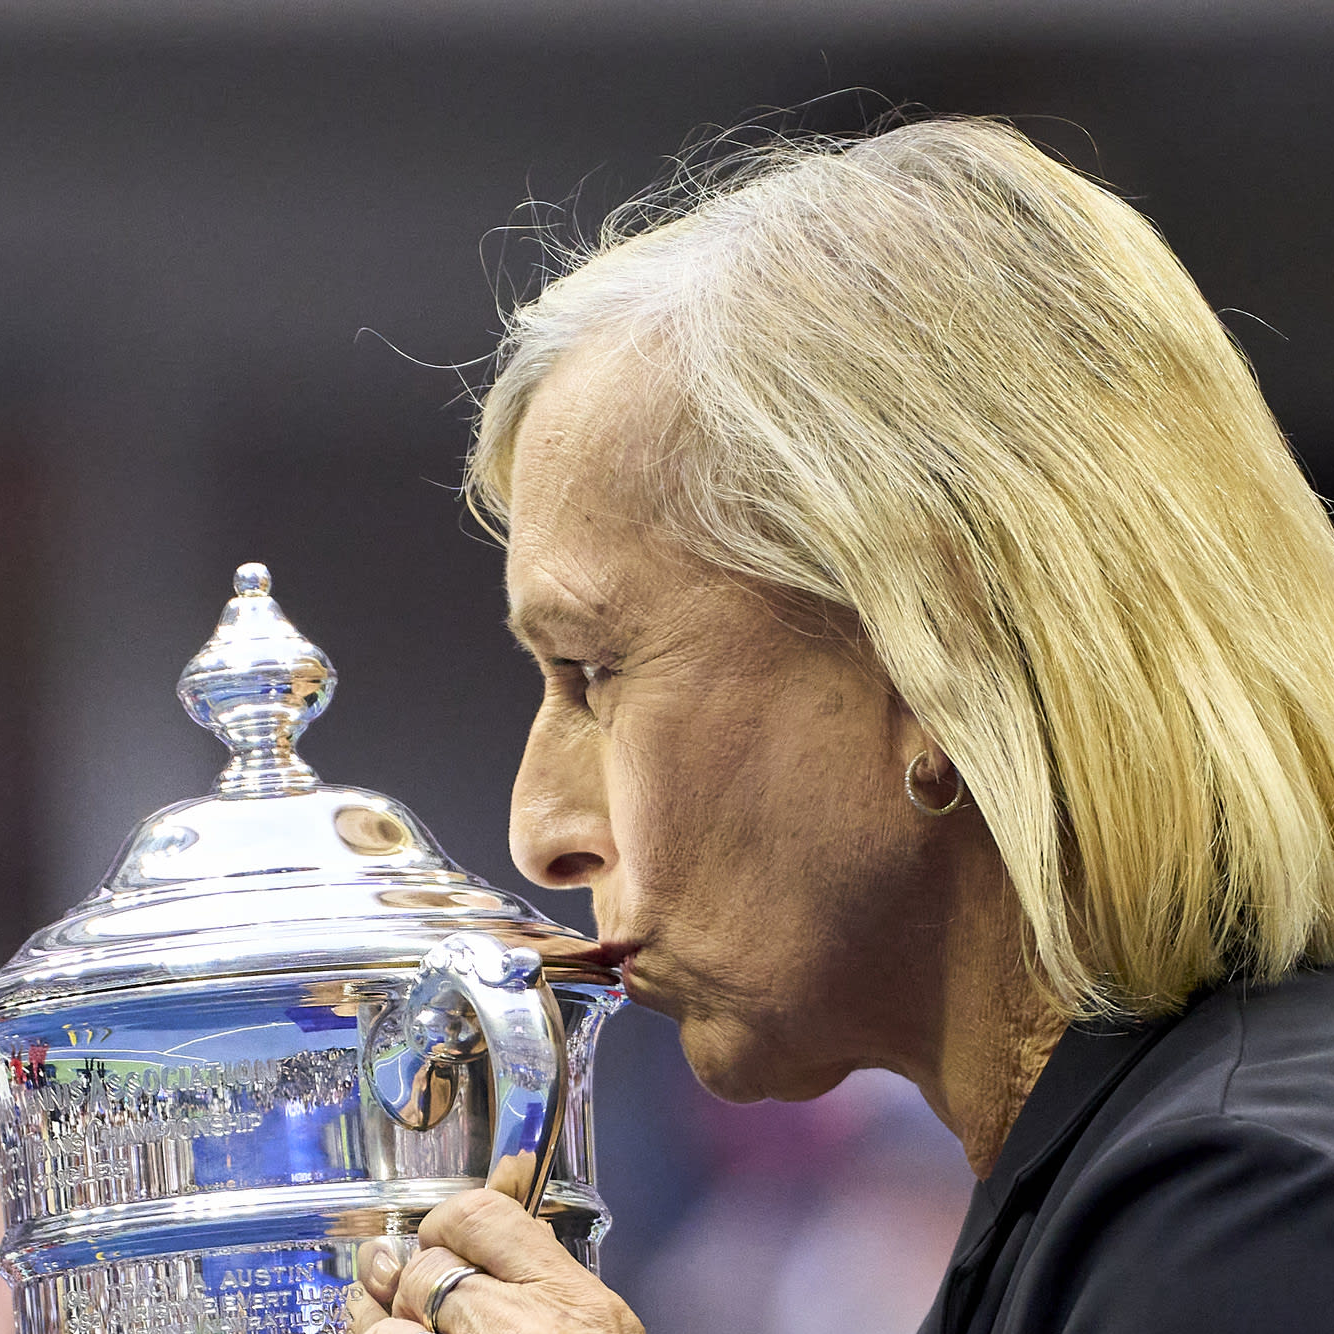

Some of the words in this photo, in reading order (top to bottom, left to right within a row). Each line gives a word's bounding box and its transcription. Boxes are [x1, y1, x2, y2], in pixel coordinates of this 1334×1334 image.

[87, 1057, 278, 1109] ASSOCIATION
[219, 1261, 316, 1291] AUSTIN
[223, 1289, 293, 1312] EVERT
[295, 1284, 365, 1306] LLOYD
